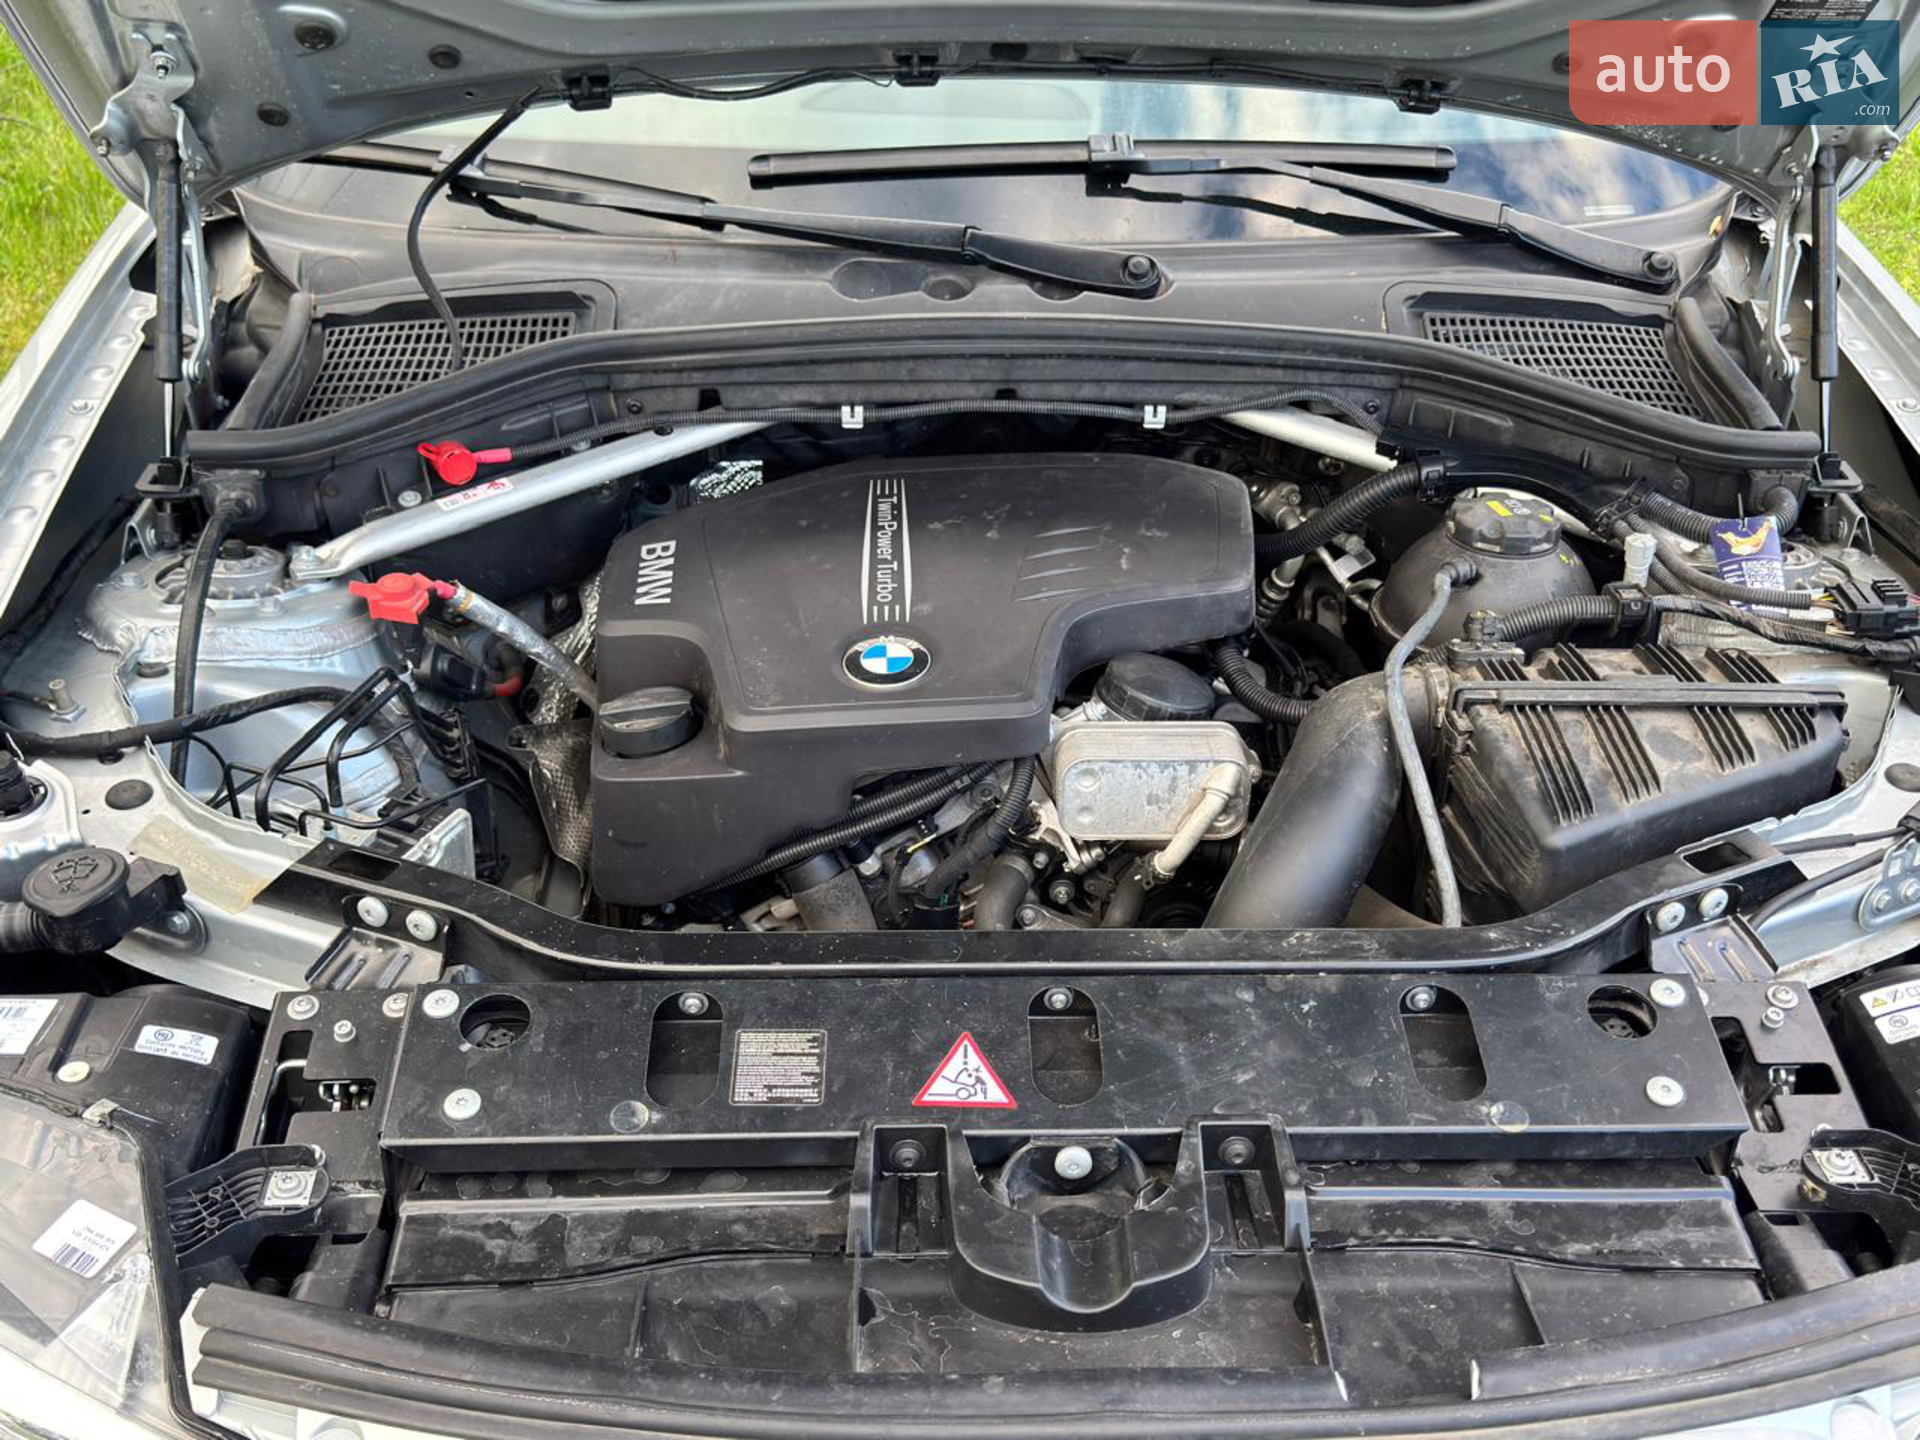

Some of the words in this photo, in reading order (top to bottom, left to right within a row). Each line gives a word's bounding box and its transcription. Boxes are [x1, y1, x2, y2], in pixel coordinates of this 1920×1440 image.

[876, 495, 898, 559] TwinPower
[634, 539, 677, 606] BMW
[876, 560, 898, 603] Turbo
